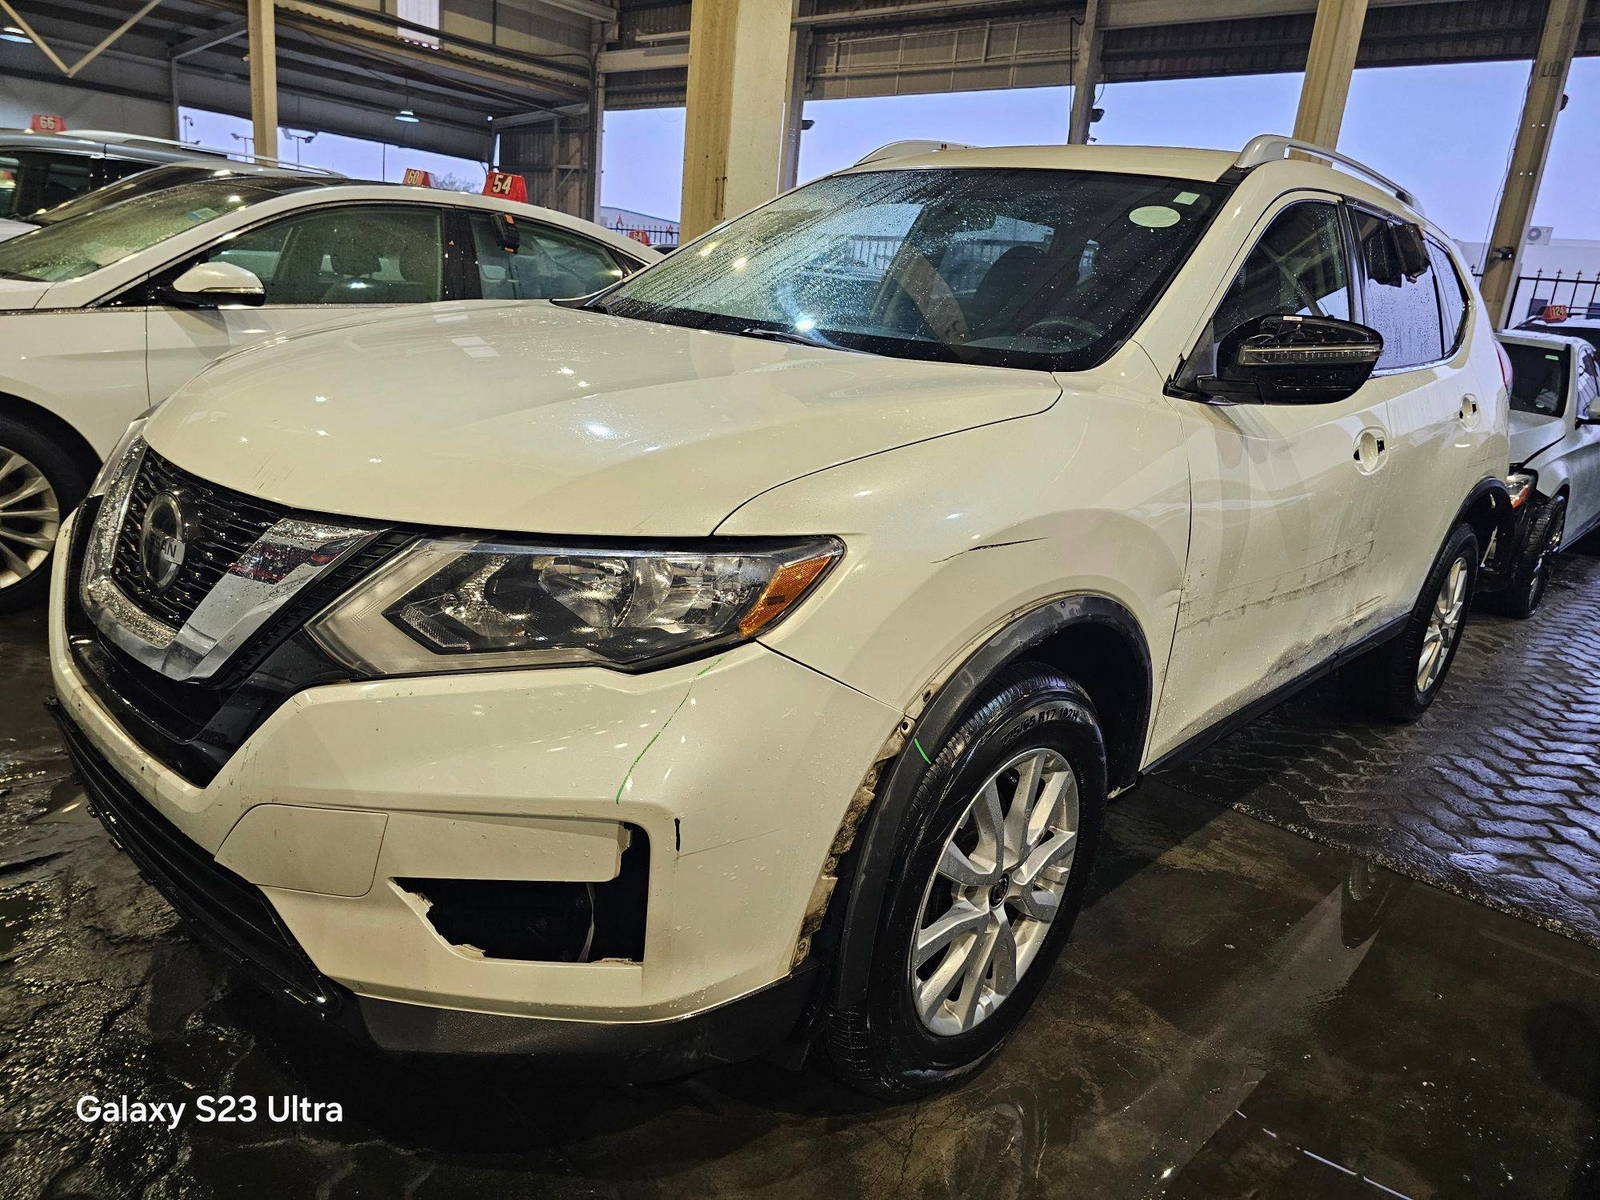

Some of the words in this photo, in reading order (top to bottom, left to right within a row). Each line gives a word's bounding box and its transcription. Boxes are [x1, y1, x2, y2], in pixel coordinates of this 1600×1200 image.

[40, 115, 56, 130] 66
[407, 170, 420, 185] 60
[492, 174, 513, 195] 54
[1039, 708, 1057, 722] R17
